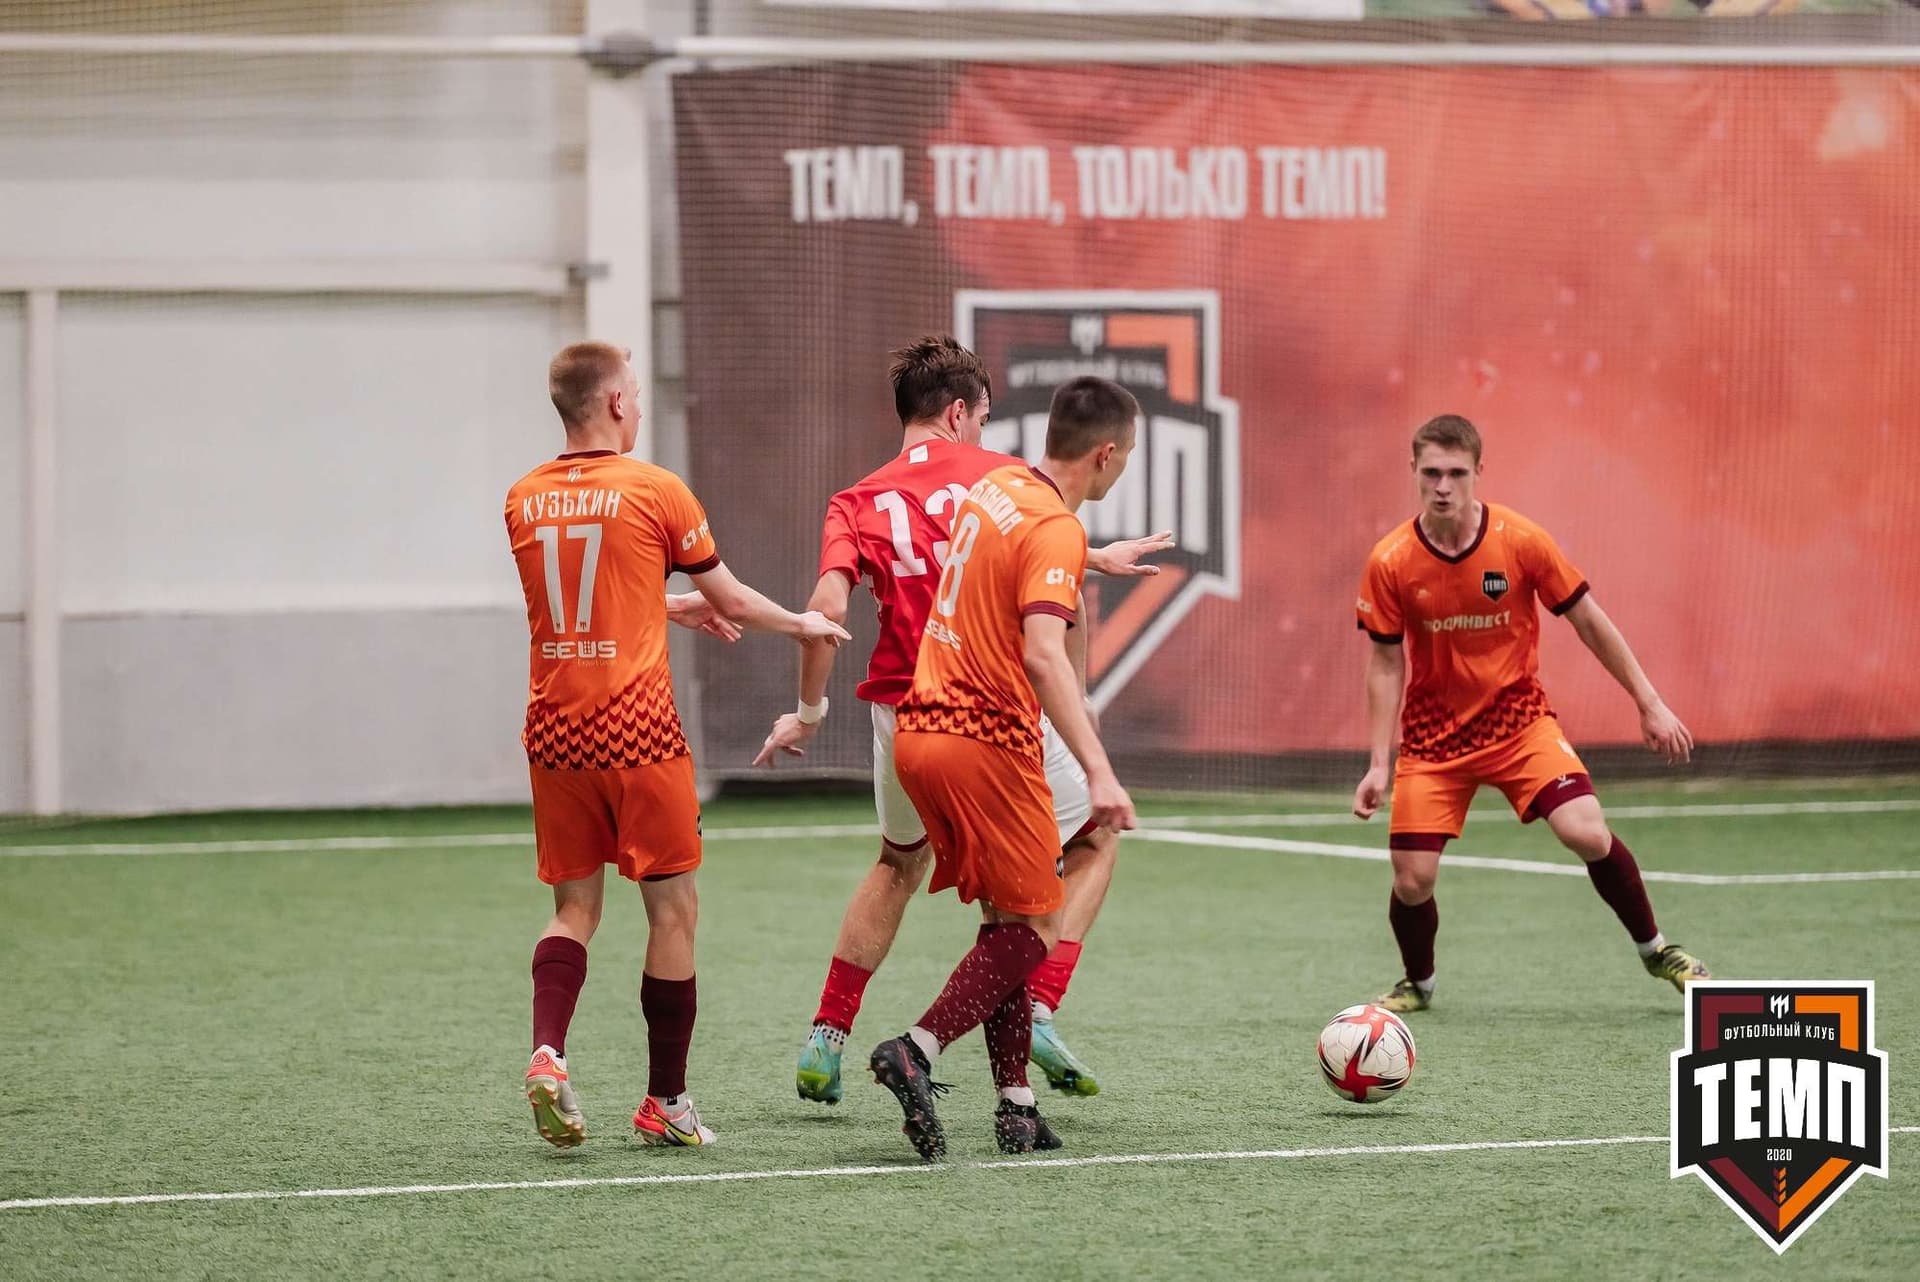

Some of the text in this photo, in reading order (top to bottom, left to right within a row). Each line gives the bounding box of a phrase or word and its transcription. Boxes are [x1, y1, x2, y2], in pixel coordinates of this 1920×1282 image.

[785, 145, 1388, 226] ТЕМП, ТЕМП, ТОЛЬКО ТЕМП!
[522, 488, 623, 525] КУЗЬКИН
[535, 523, 603, 635] 17
[937, 512, 981, 618] 8
[541, 639, 617, 660] SEUS
